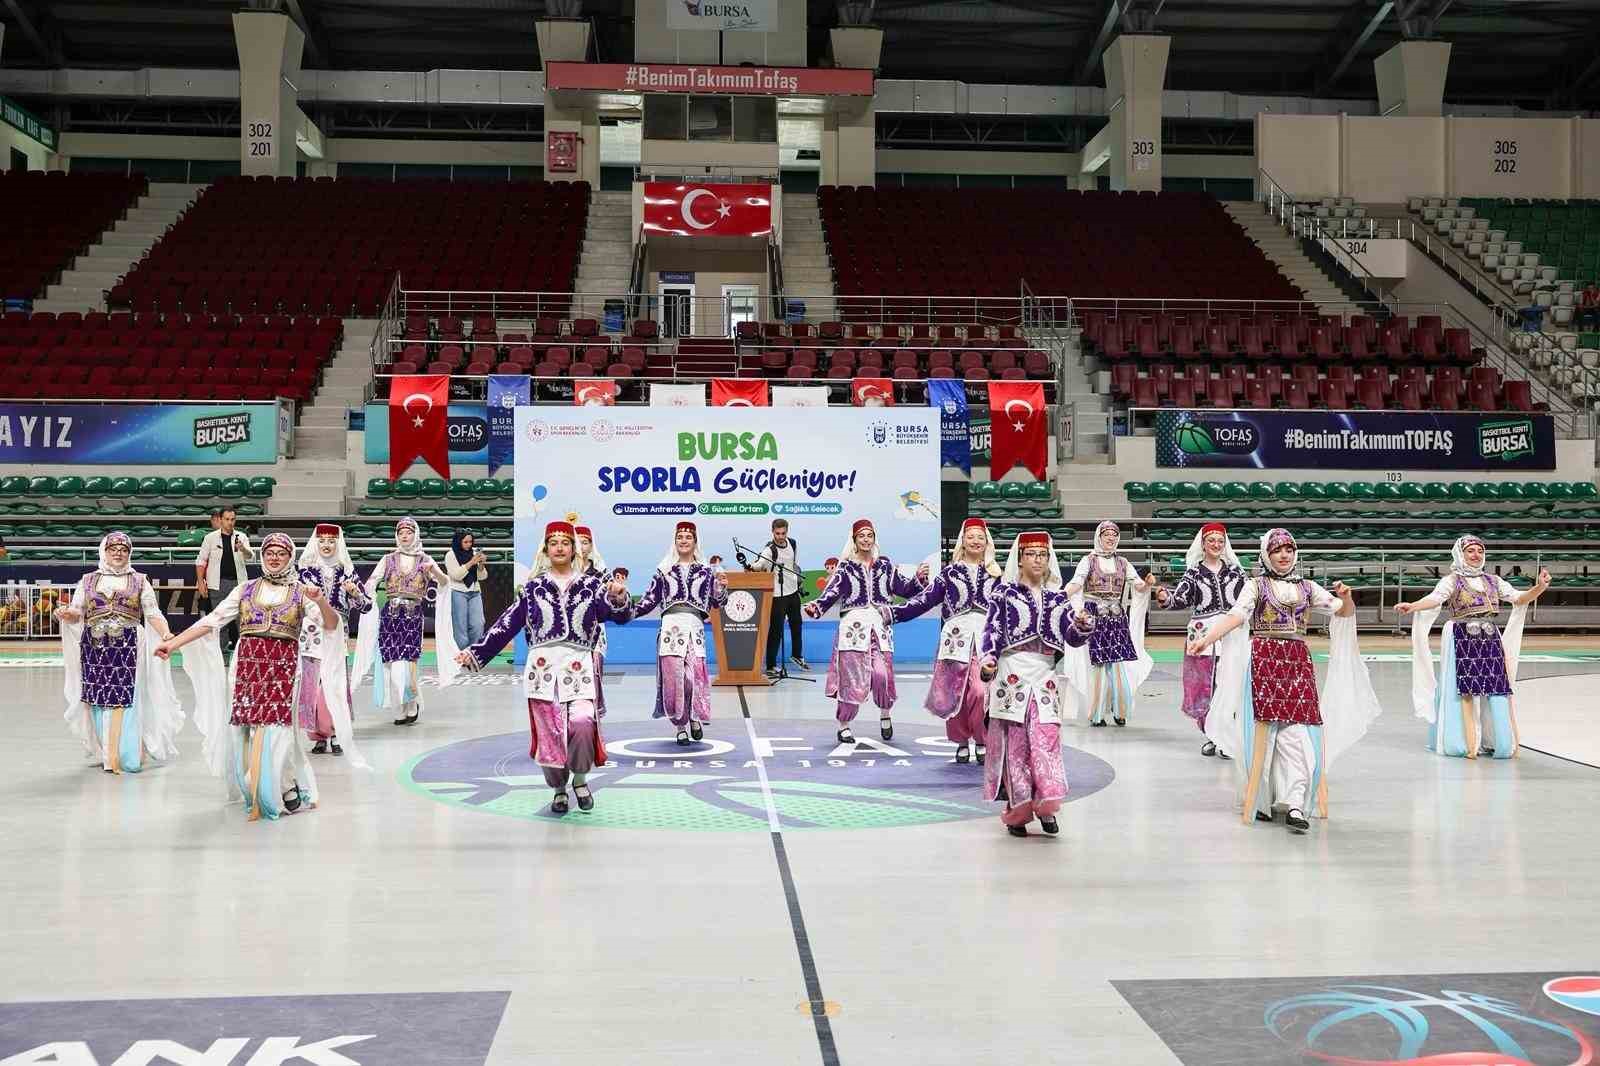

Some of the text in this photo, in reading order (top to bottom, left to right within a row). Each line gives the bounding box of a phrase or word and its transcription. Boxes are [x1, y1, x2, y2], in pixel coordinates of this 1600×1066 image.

[704, 5, 751, 17] BURSA
[626, 66, 798, 91] #BenimTakımımTofaş
[249, 124, 272, 137] 302
[251, 142, 271, 156] 201
[1132, 142, 1154, 155] 303
[1495, 141, 1517, 154] 305
[1494, 159, 1516, 173] 202
[1347, 241, 1367, 255] 304
[491, 417, 513, 425] BUR
[942, 422, 967, 430] URSA
[196, 424, 247, 446] BURSA
[448, 424, 483, 441] OFAŞ
[896, 425, 929, 433] BURSA
[970, 434, 992, 450] BUR
[1214, 428, 1252, 445] TOFAŞ
[1284, 428, 1453, 455] #BenimTakımımTOFAŞ
[677, 432, 778, 461] BURSA
[1482, 434, 1529, 454] BURSA
[598, 466, 701, 493] SPORLA
[1386, 472, 1402, 482] 103
[624, 505, 648, 513] Uzman
[739, 505, 763, 513] Ortam
[797, 759, 912, 768] 1974
